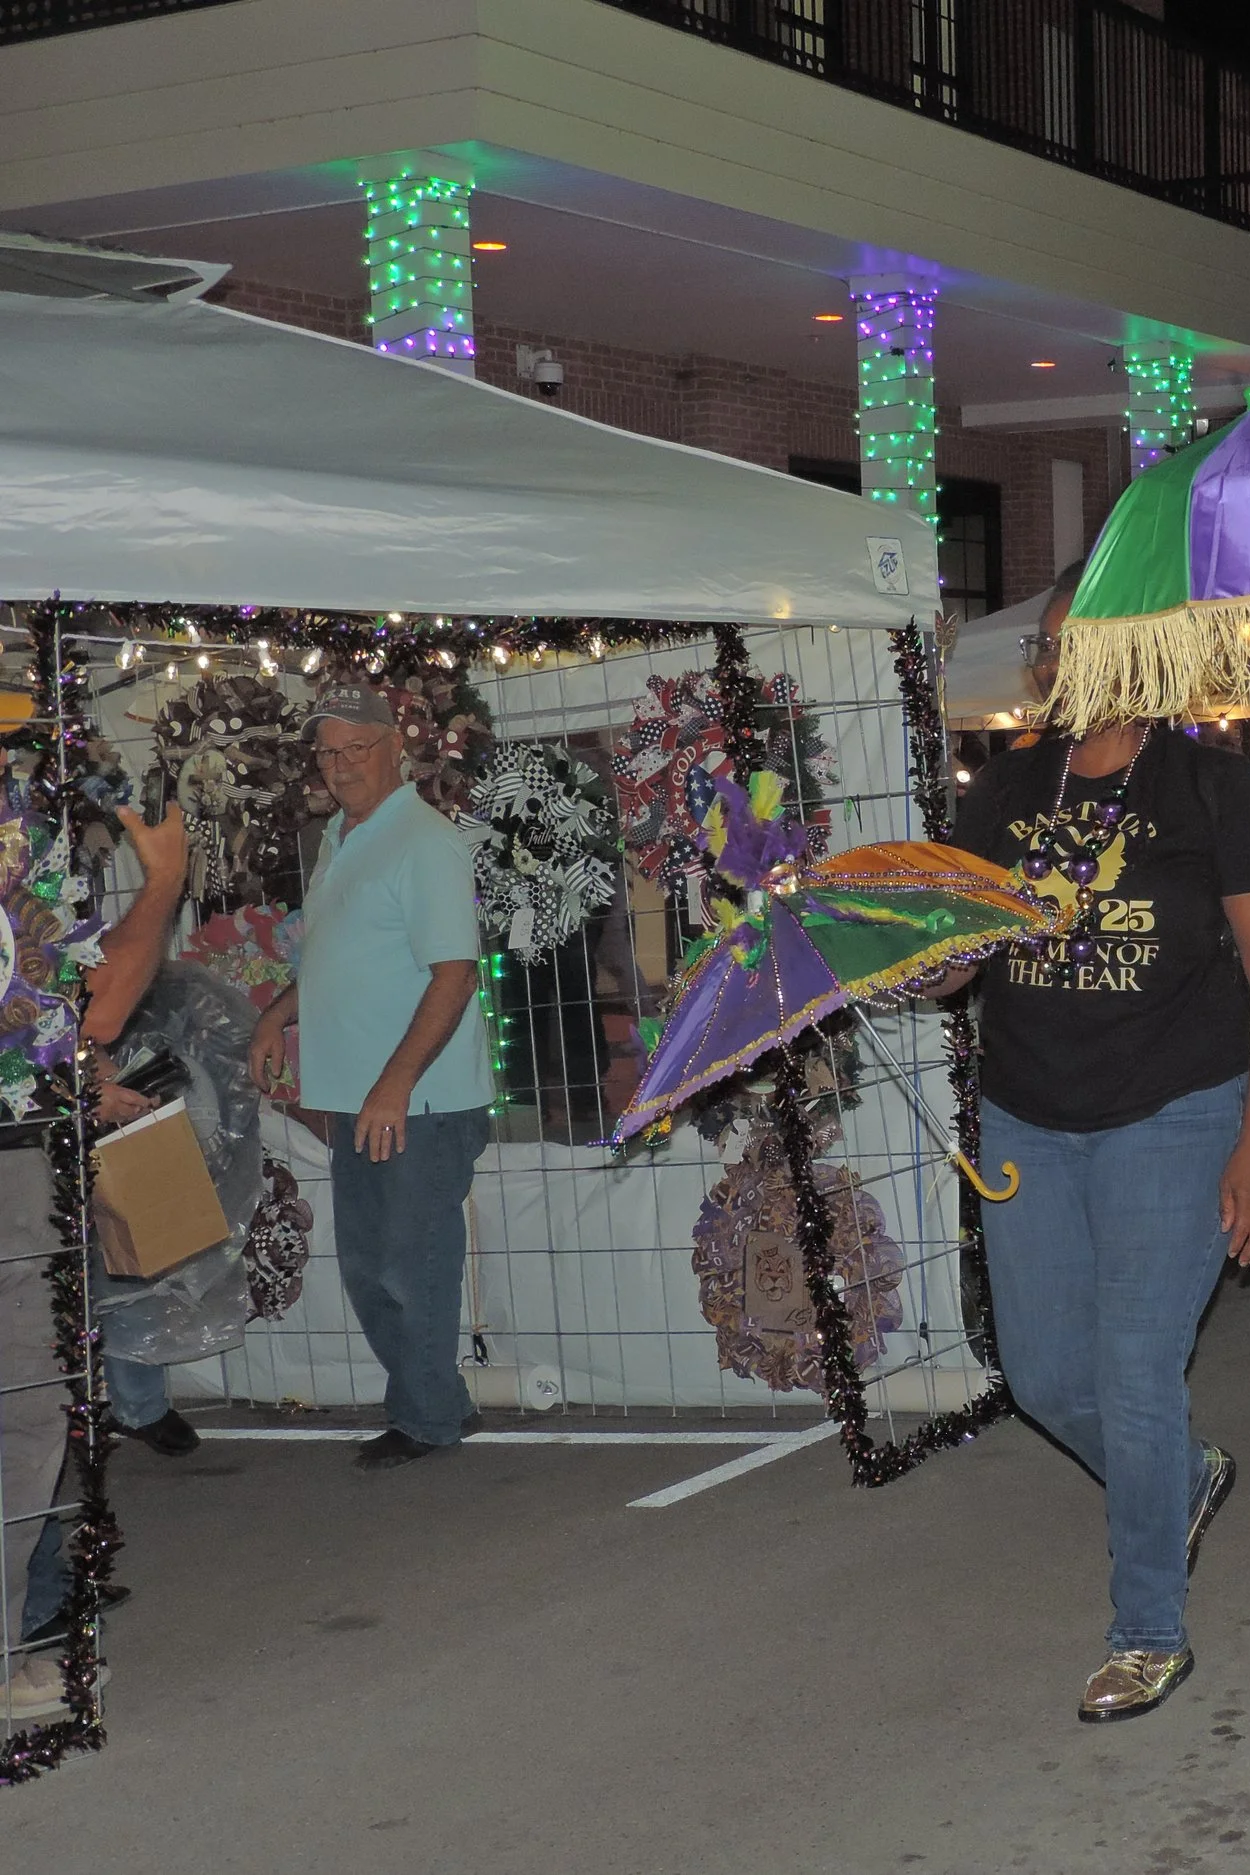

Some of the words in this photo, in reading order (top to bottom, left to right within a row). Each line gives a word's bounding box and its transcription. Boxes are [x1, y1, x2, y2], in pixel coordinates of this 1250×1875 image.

[671, 745, 698, 787] GOD
[1007, 801, 1158, 842] BASTOP
[1116, 942, 1160, 966] OF
